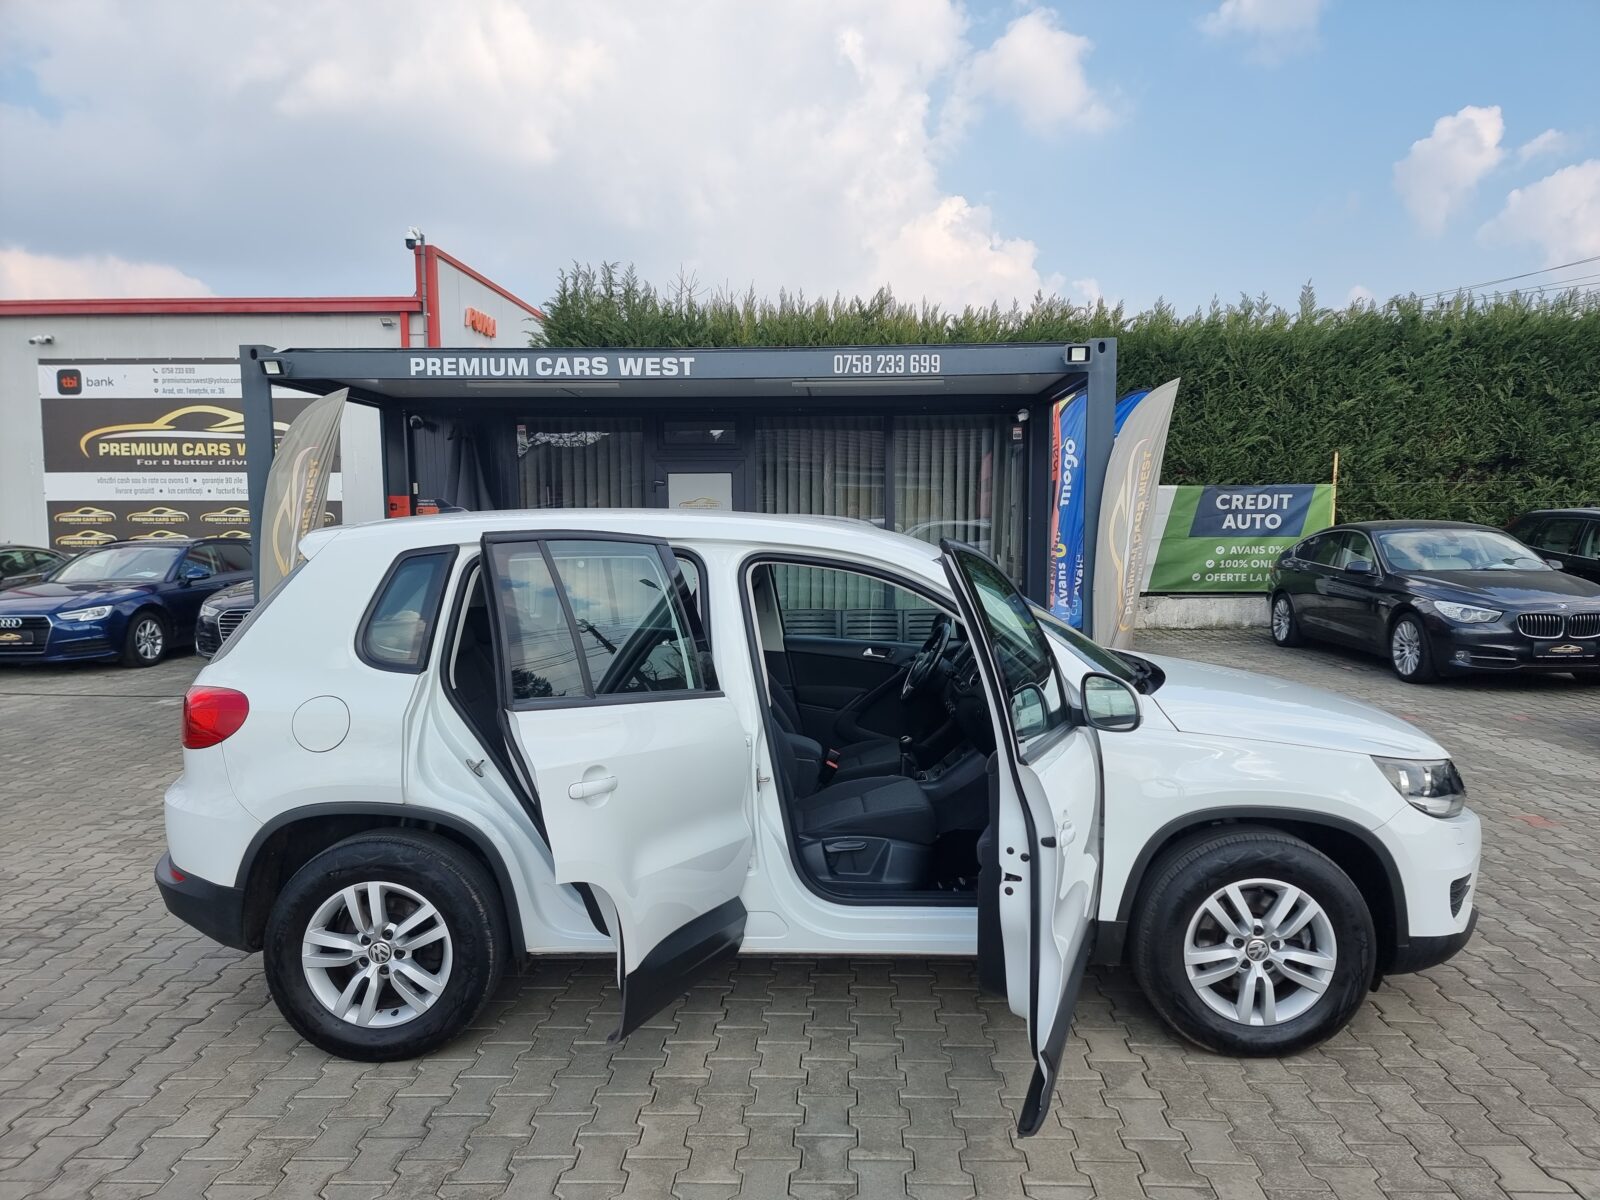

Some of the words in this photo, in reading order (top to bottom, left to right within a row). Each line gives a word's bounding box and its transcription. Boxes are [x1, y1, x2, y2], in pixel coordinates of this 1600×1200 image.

[410, 357, 529, 376] PREMIUM
[535, 357, 609, 376] CARS
[618, 357, 695, 376] WEST
[834, 354, 872, 374] 0758
[877, 354, 905, 374] 233
[910, 354, 941, 373] 699
[86, 376, 115, 387] bank
[99, 443, 178, 456] PREMIUM
[182, 443, 231, 456] CARS
[1060, 439, 1079, 506] mogo
[1215, 493, 1293, 510] CREDIT
[1221, 513, 1283, 530] AUTO
[1229, 545, 1266, 555] AVANS
[1219, 559, 1249, 568] 100%
[1250, 559, 1274, 568] ONL
[1058, 562, 1069, 607] Avans
[1205, 573, 1247, 582] OFERTE
[1249, 573, 1263, 582] LA
